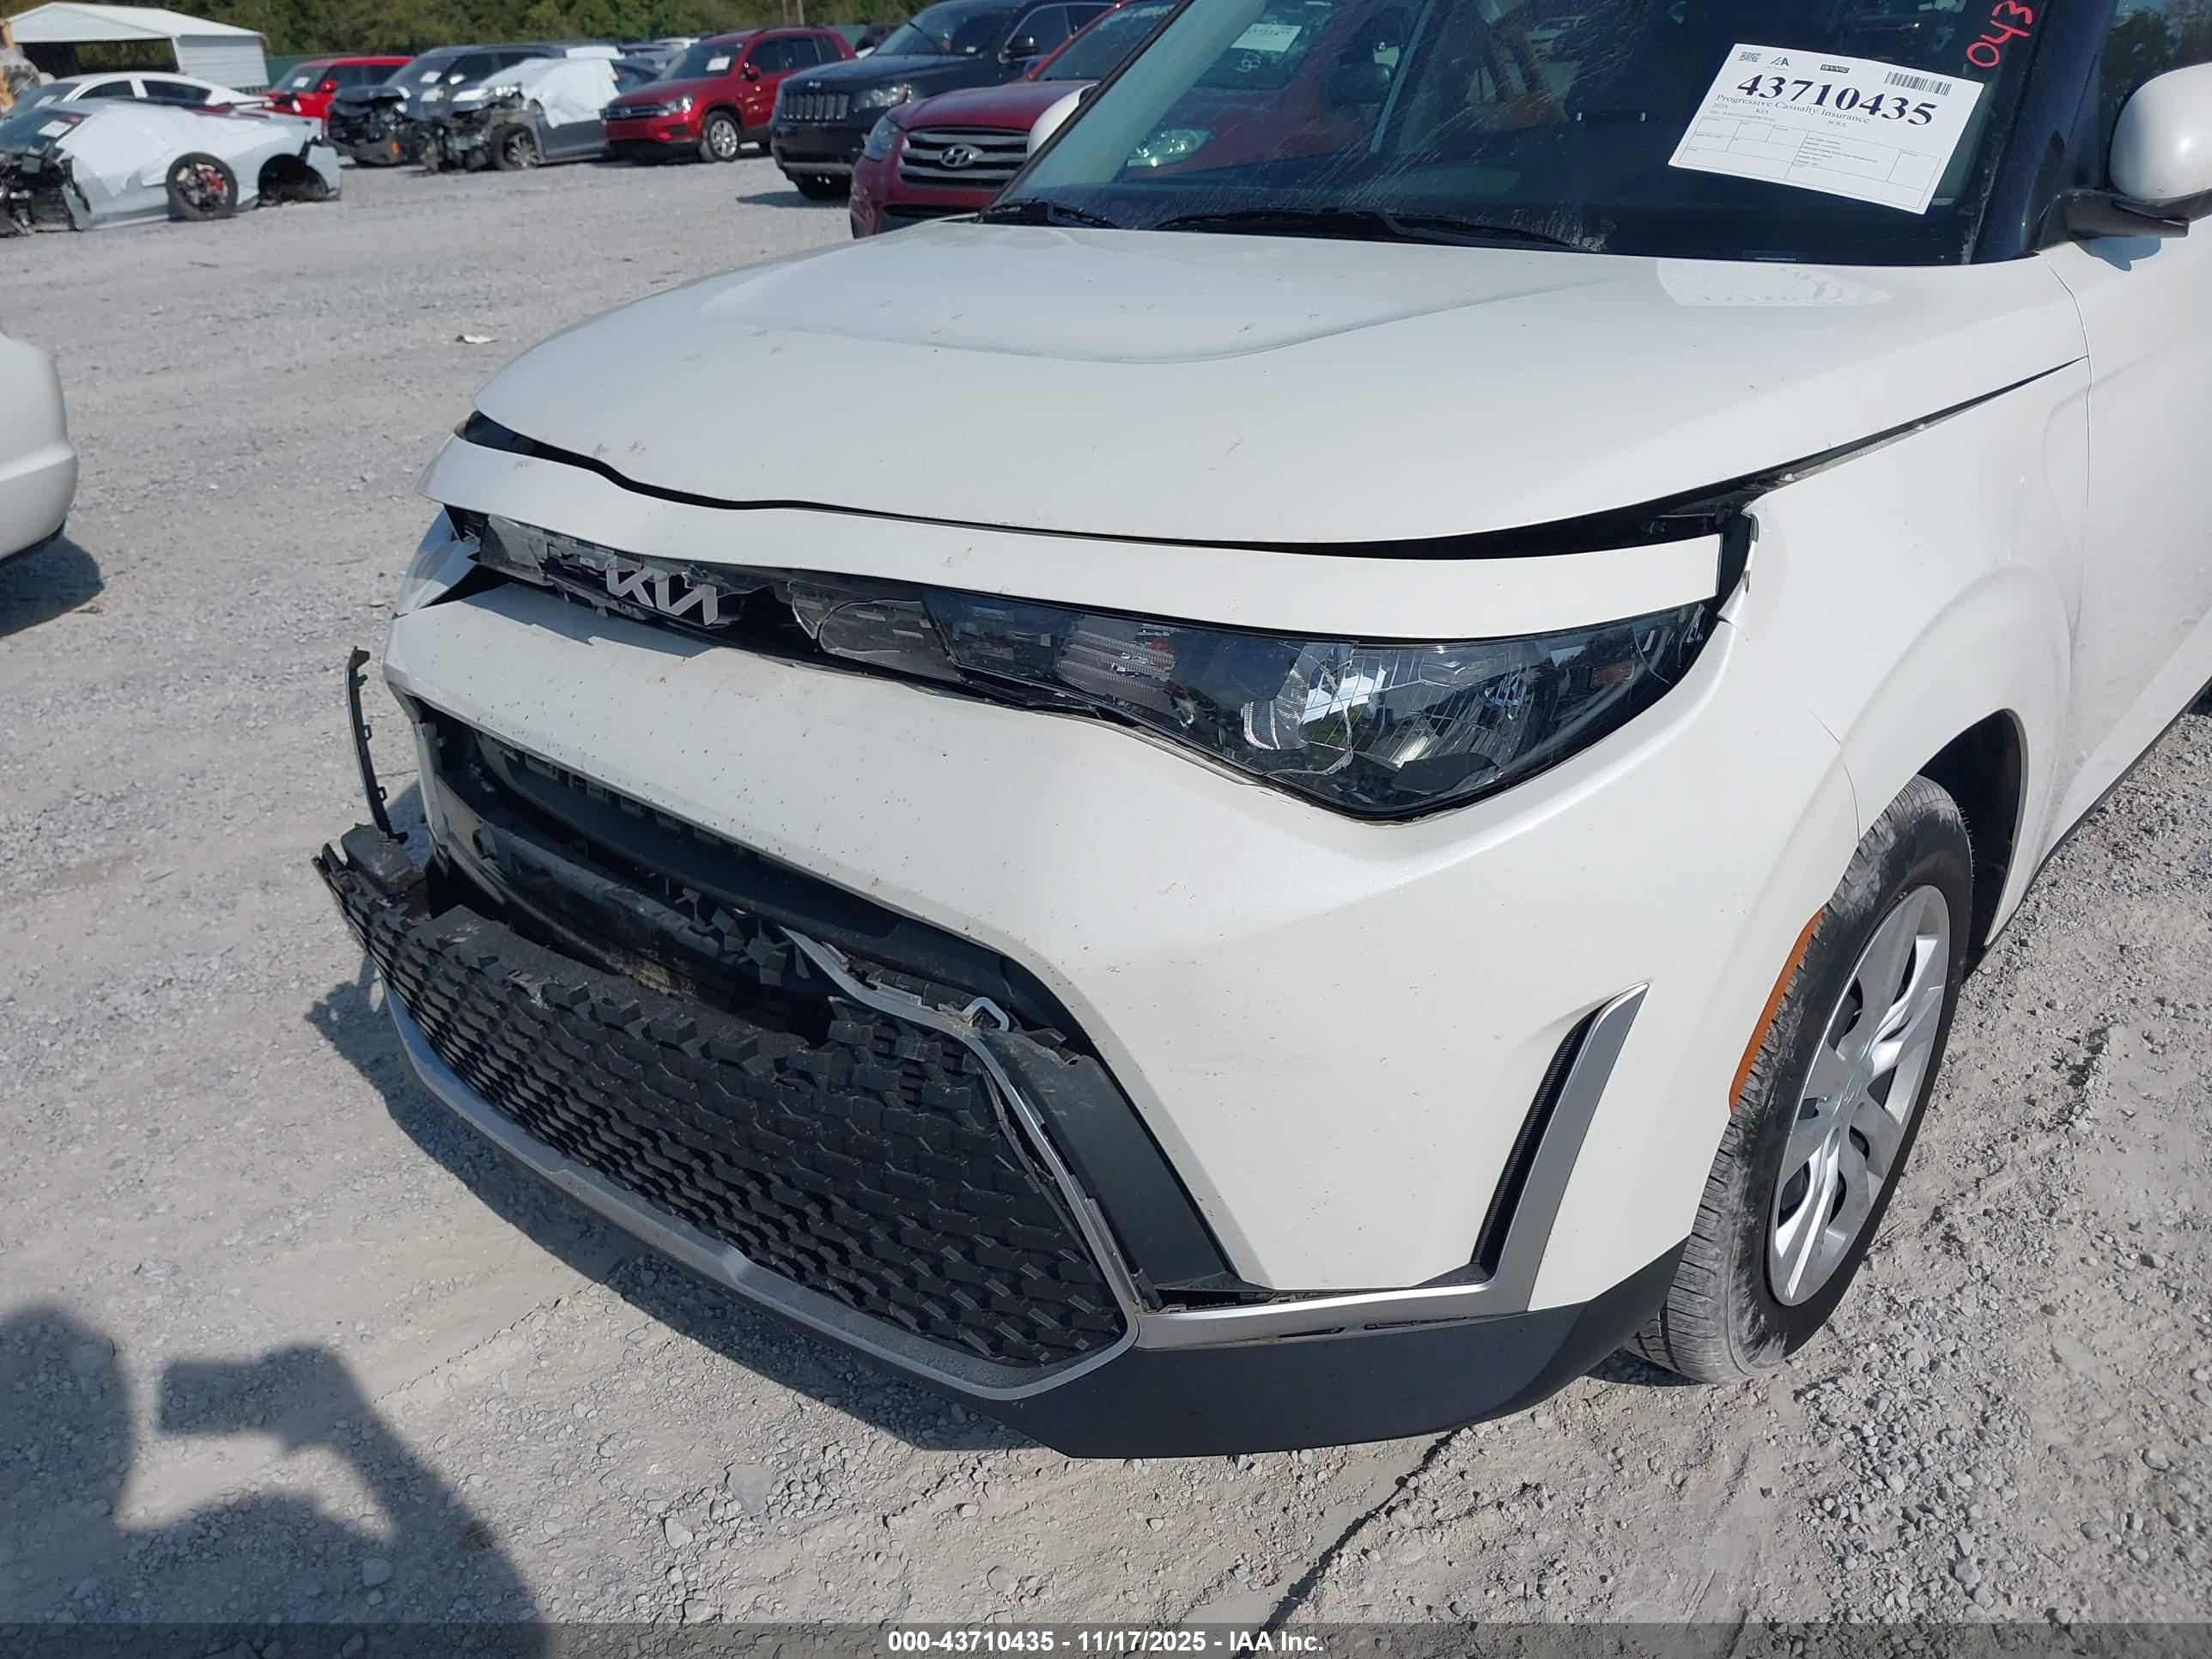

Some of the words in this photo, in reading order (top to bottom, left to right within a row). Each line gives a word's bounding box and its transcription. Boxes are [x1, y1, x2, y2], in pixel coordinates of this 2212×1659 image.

[1716, 94, 1773, 108] Progressive
[1775, 100, 1819, 116] Casualty
[1820, 109, 1870, 124] Insurance
[1736, 74, 1938, 125] 43710435
